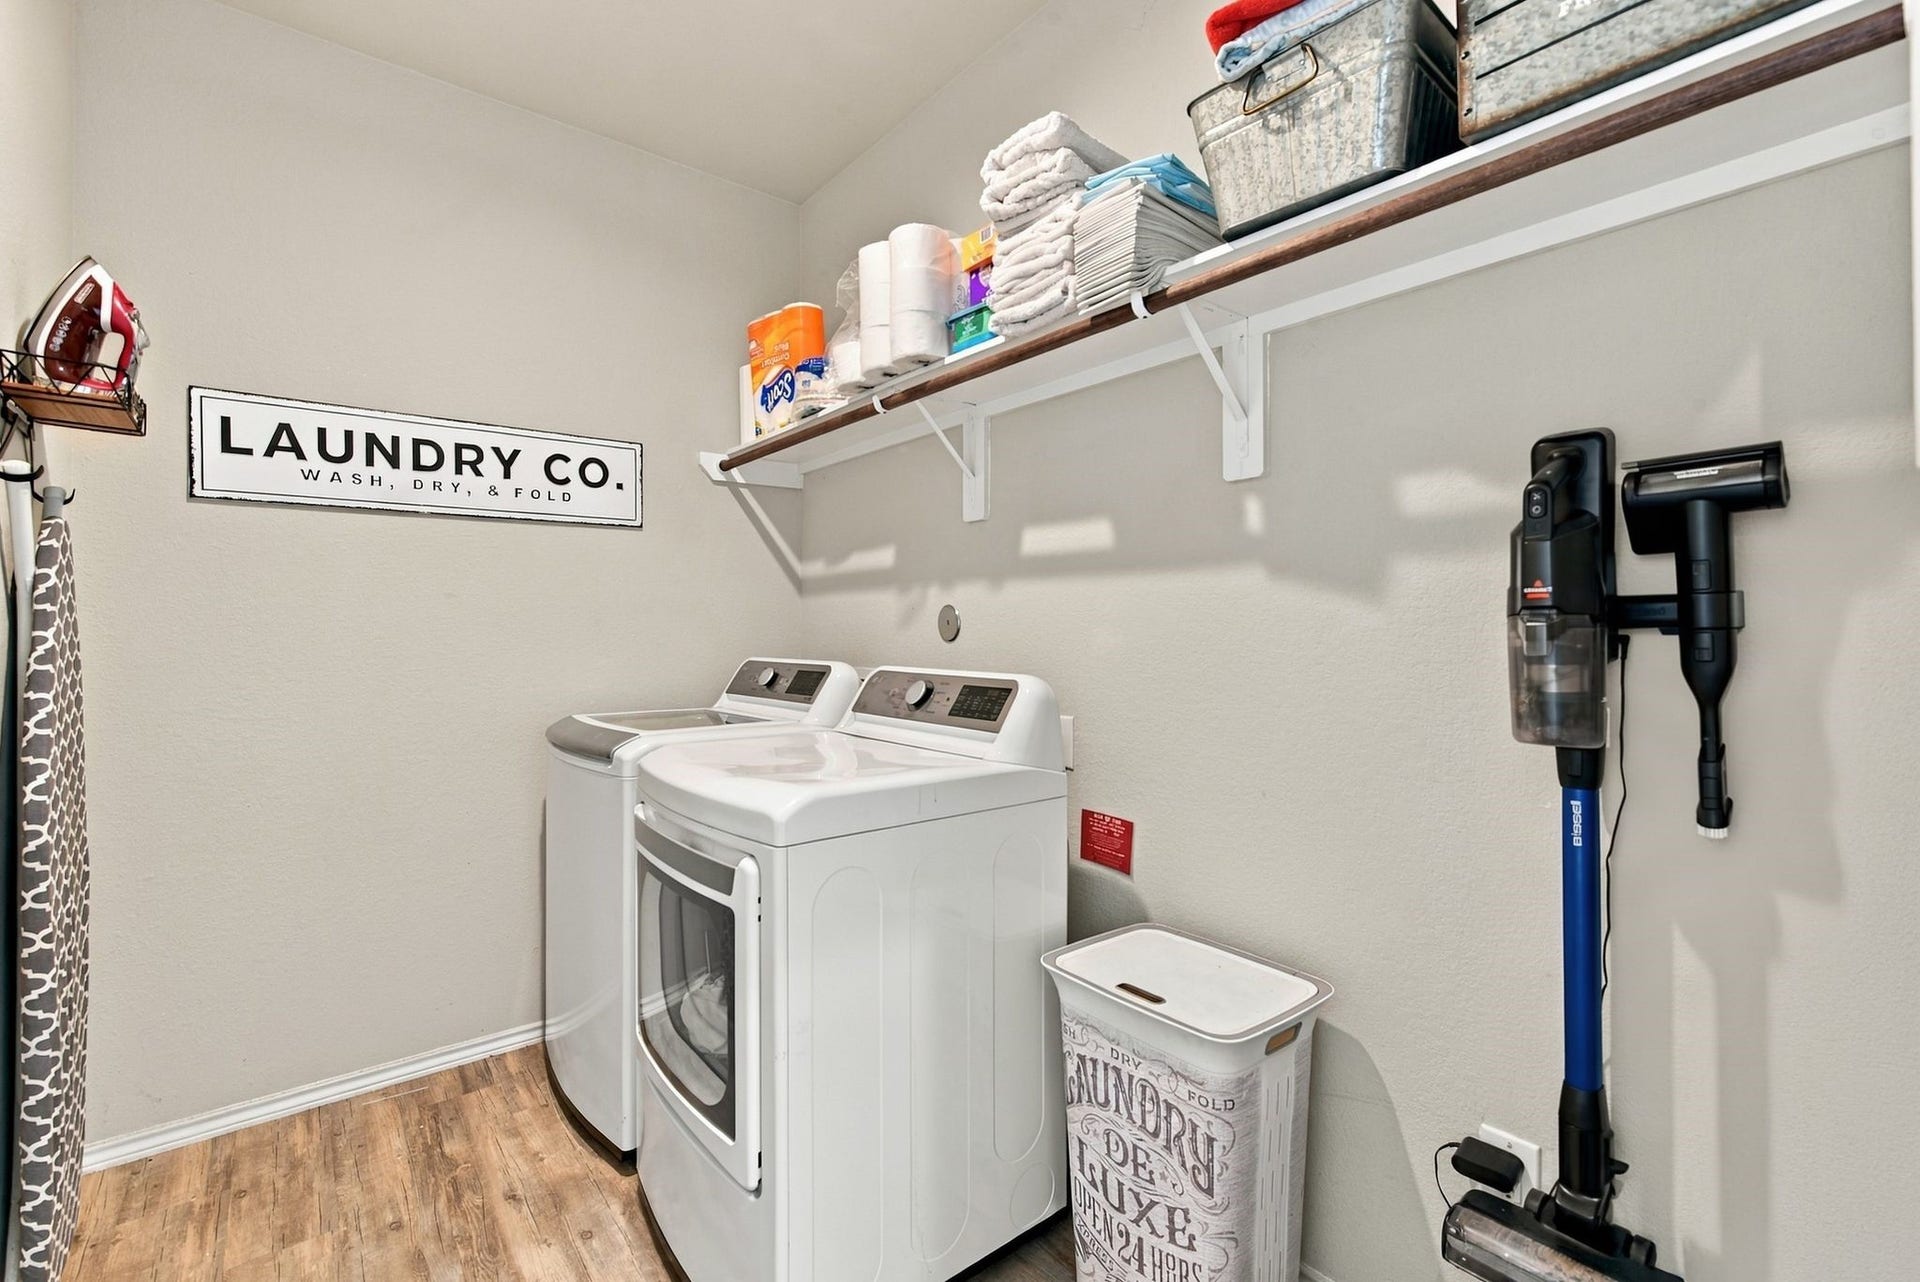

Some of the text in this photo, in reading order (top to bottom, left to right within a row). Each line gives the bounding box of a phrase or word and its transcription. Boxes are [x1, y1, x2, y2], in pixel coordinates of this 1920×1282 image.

[220, 415, 624, 490] LAUNDRY CO.
[301, 467, 572, 502] WASH, DRY, & FOLD
[1110, 1046, 1142, 1070] DRY
[1187, 1089, 1236, 1111] FOLD
[1103, 1128, 1156, 1185] DE
[1077, 1136, 1197, 1252] LUXE
[1074, 1176, 1114, 1250] OPEN
[1116, 1221, 1148, 1278] 24
[1074, 1213, 1114, 1272] XPRESS
